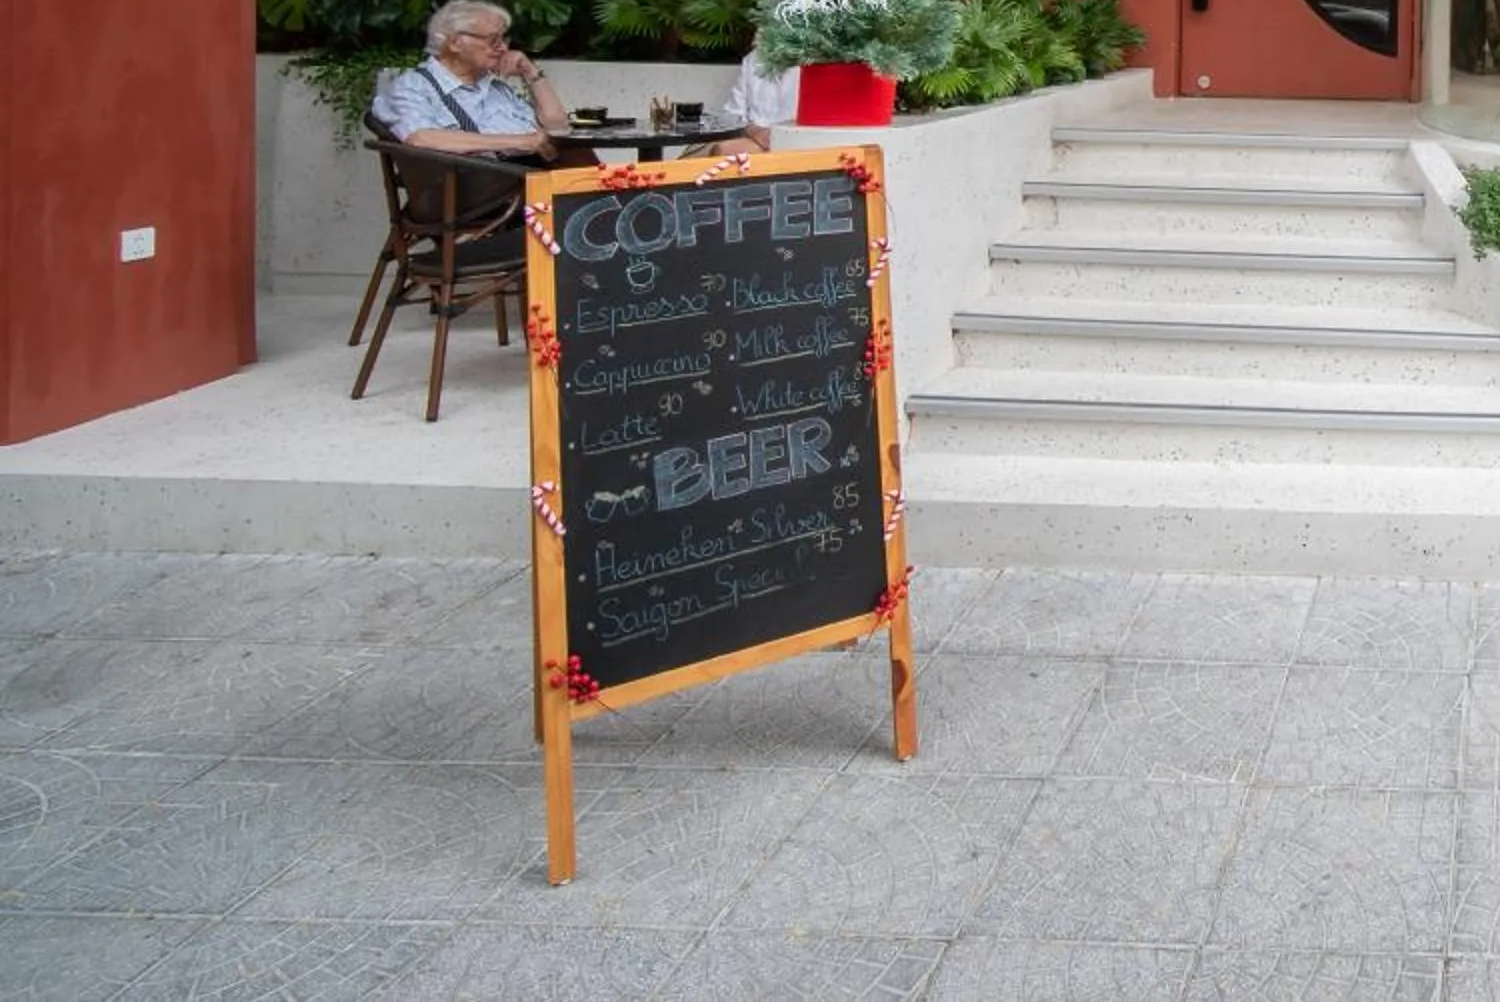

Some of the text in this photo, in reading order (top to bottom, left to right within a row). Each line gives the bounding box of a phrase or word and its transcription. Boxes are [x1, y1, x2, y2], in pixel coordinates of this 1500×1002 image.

[563, 177, 855, 261] COFFEE
[733, 257, 865, 308] Black coffee 65
[577, 292, 708, 338] Espresso
[735, 306, 869, 361] Milk coffee 75
[582, 393, 683, 448] Latte 90
[736, 379, 803, 415] White
[653, 416, 834, 512] BEER
[595, 482, 860, 585] Heineken Silver 85
[598, 597, 706, 643] Saigon
[814, 524, 844, 553] 75
